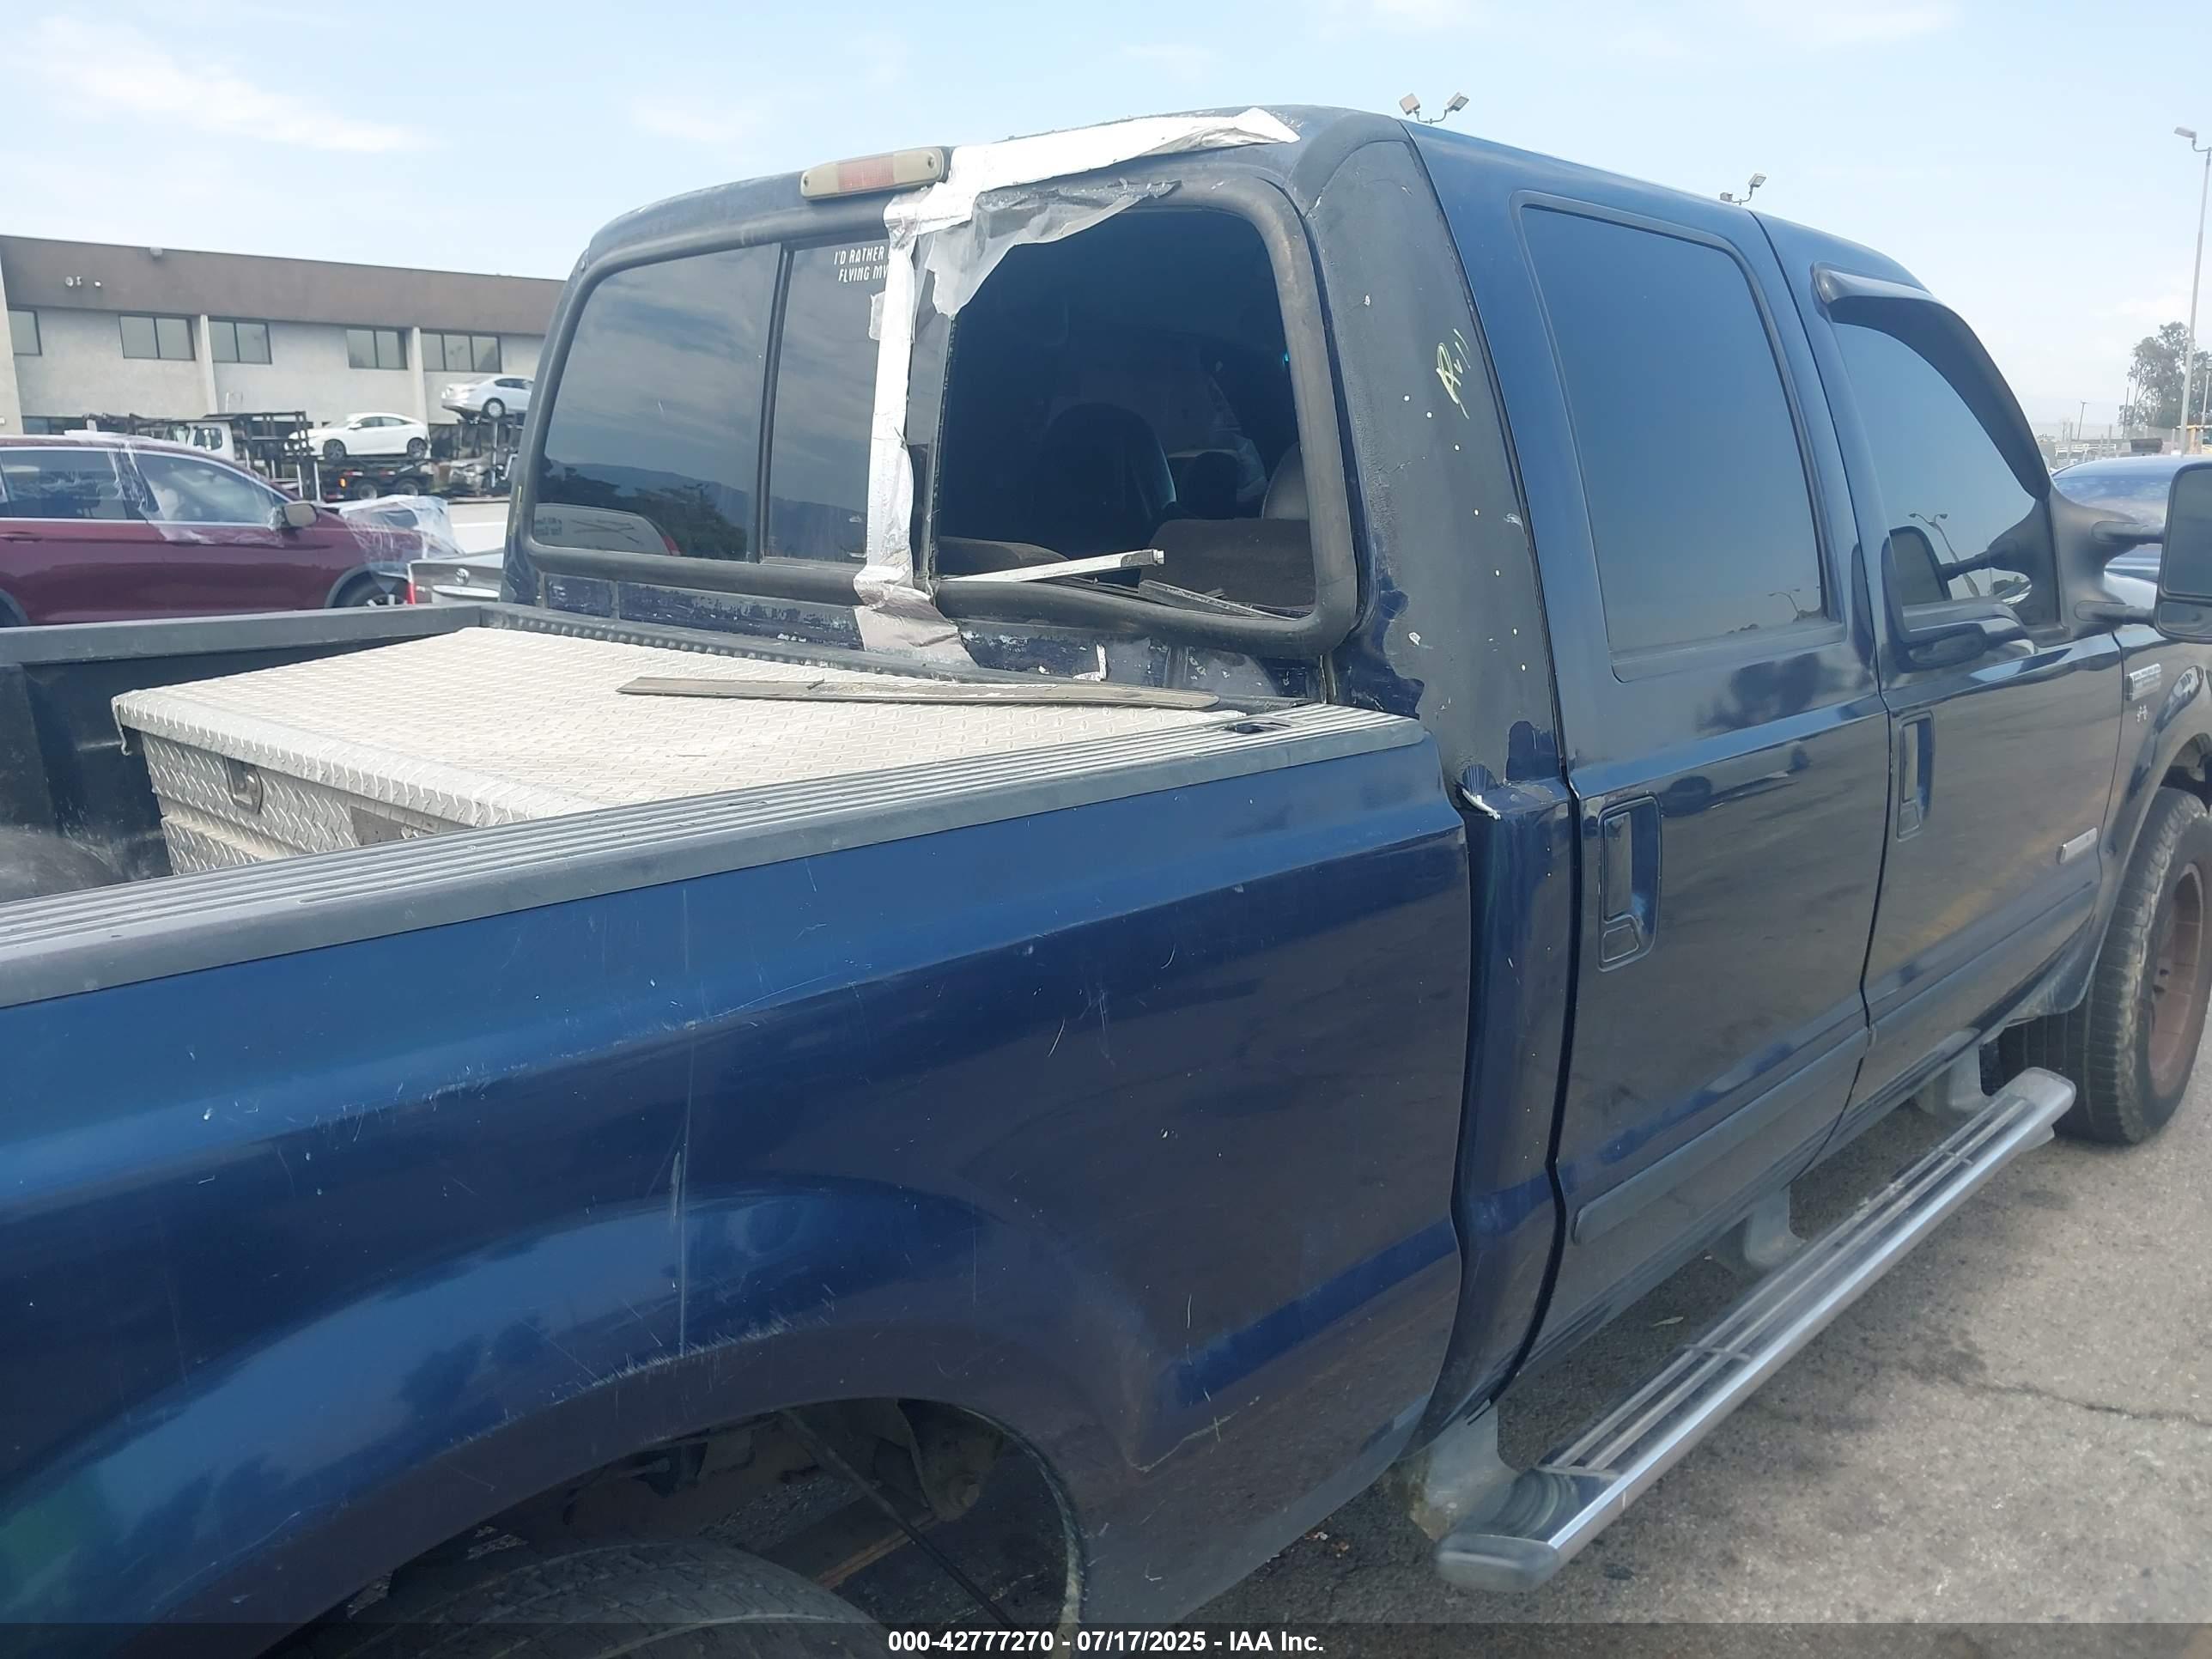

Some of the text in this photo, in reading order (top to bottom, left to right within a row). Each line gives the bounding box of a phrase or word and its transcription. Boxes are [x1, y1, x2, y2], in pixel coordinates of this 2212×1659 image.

[834, 246, 885, 265] I'D RATHER
[838, 266, 870, 283] FLYING
